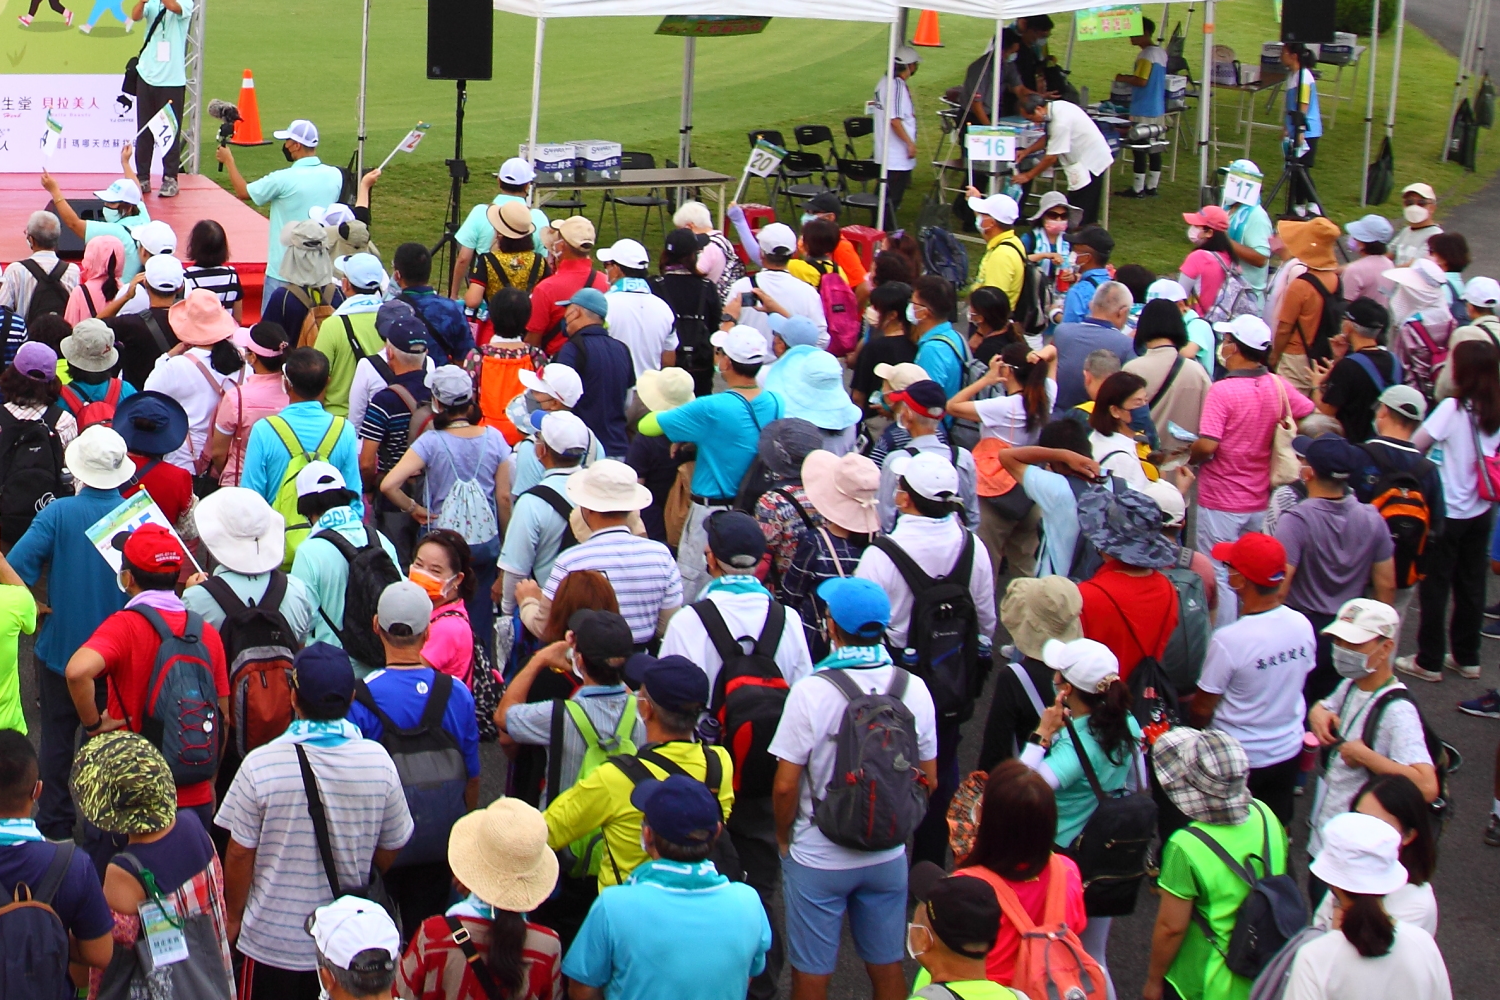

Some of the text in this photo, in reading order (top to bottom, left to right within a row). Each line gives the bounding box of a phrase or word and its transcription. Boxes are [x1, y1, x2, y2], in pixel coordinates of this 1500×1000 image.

[158, 124, 172, 148] 14
[406, 133, 421, 149] 2
[984, 138, 1006, 156] 16
[750, 153, 773, 171] 20
[1236, 180, 1254, 200] 17
